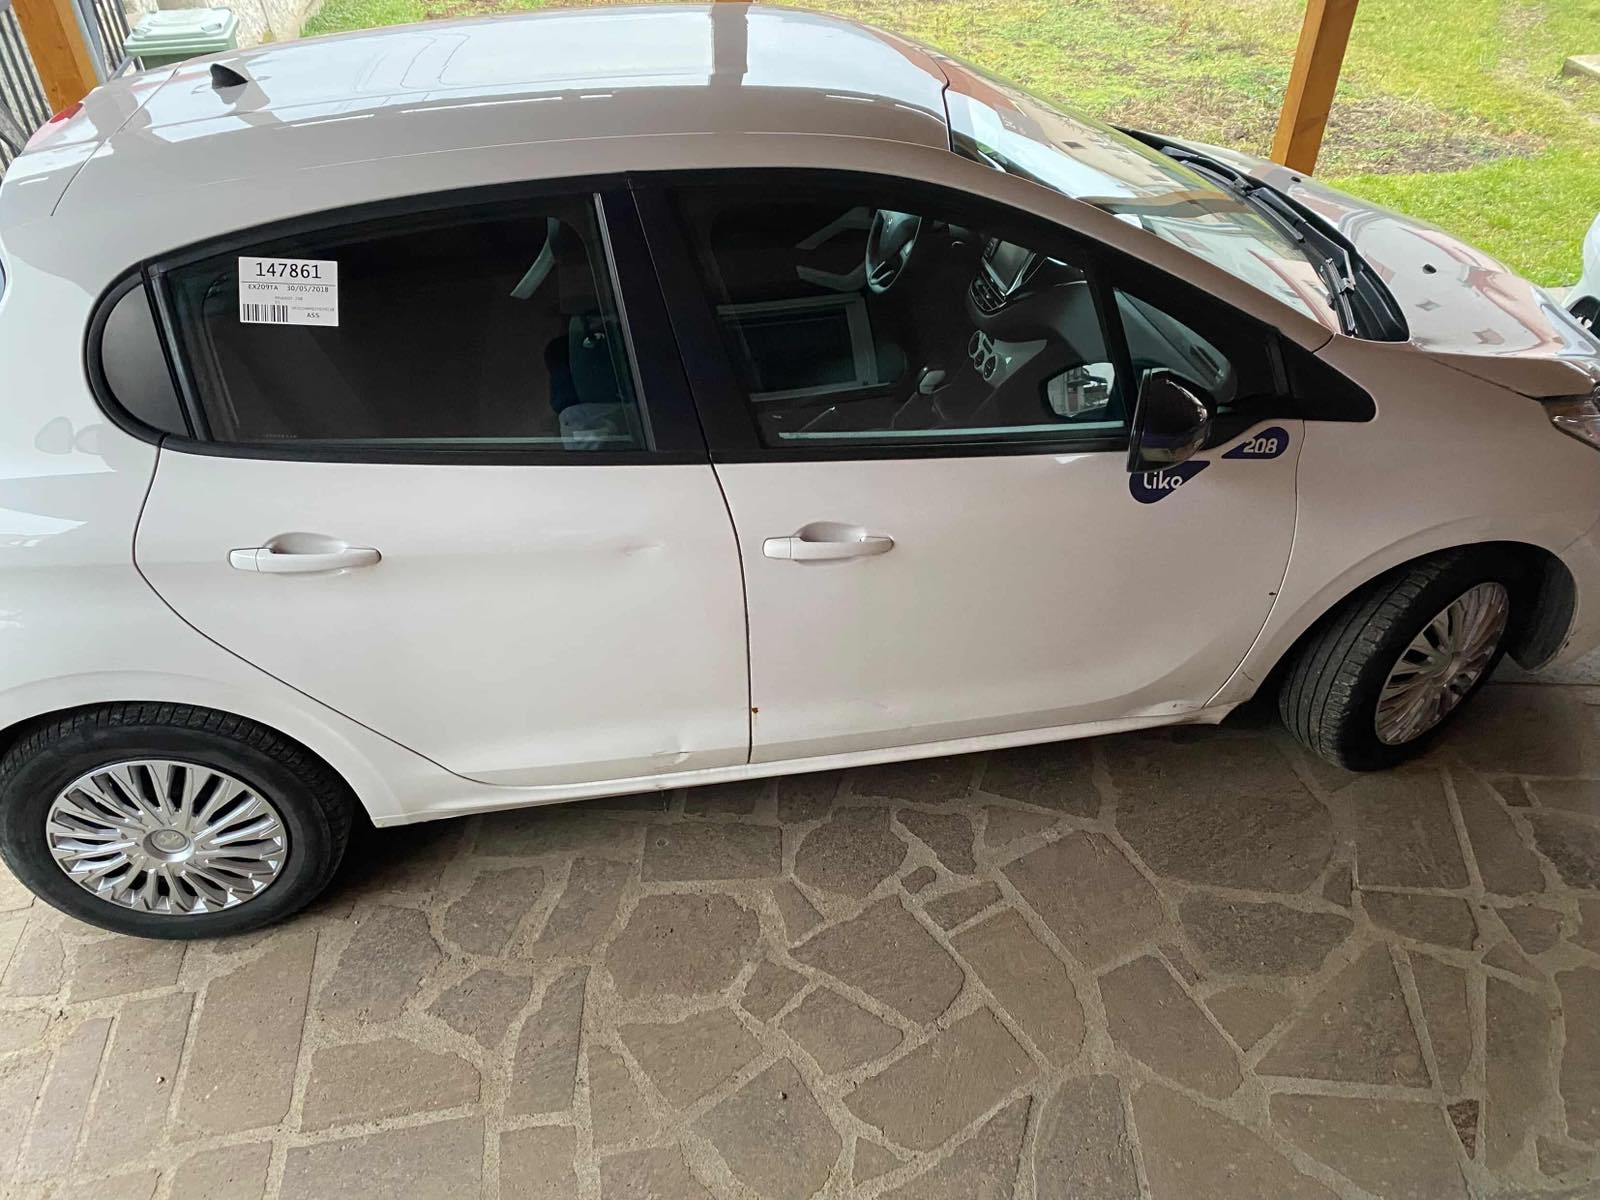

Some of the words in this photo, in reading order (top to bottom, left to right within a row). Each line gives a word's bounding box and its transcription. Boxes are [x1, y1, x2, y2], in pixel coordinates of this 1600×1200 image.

[255, 262, 322, 279] 147861
[287, 284, 329, 293] 30/05/2018
[1243, 437, 1279, 454] 208
